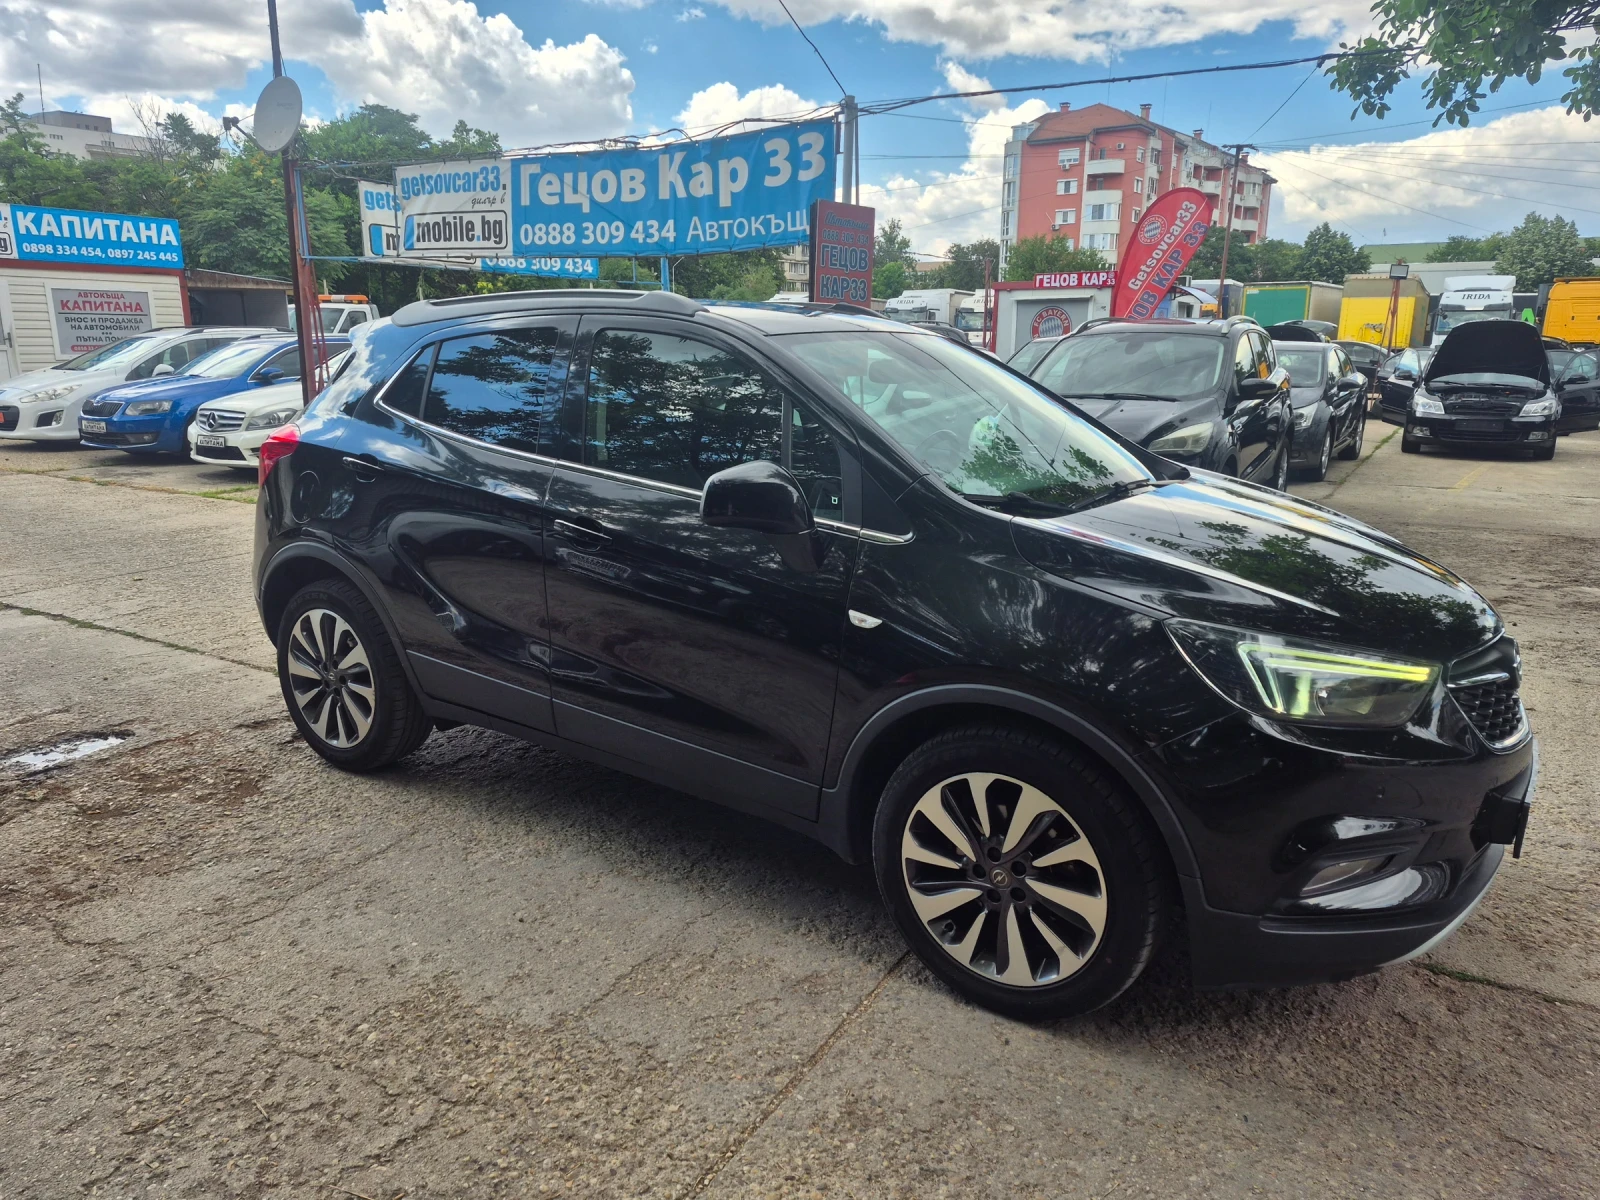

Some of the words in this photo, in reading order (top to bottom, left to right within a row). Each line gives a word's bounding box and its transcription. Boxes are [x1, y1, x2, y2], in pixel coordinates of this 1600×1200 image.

[519, 163, 646, 214] Гецов
[658, 151, 749, 208] Кар
[763, 131, 826, 188] 33
[15, 211, 179, 246] КАПИТАНА
[416, 214, 503, 245] mobile.bg
[519, 222, 575, 246] 0888
[582, 221, 625, 244] 309
[630, 219, 676, 243] 434
[687, 208, 810, 242] Автокъщ
[22, 242, 54, 254] 0898
[56, 245, 78, 256] 334
[80, 247, 105, 259] 454,
[107, 248, 134, 259] 0897
[137, 250, 156, 261] 245
[158, 251, 179, 262] 445
[1128, 201, 1197, 290] Getsovcar33
[1151, 248, 1184, 289] КАР
[1183, 221, 1209, 247] 33
[564, 258, 593, 273] 434
[821, 243, 869, 274] ГЕЦОВ
[820, 274, 868, 302] КАР33
[1035, 273, 1078, 288] ГЕЦОВ
[1081, 272, 1107, 286] КАР
[77, 291, 125, 300] АВТОКЪЩА
[60, 299, 144, 313] КАПИТАНА
[65, 316, 89, 324] ВНОС
[98, 316, 144, 324] ПРОДАЖБА
[84, 324, 140, 332] АВТОМОБИЛИ
[1042, 309, 1069, 327] BAYERN
[76, 335, 103, 343] ПЪТНА
